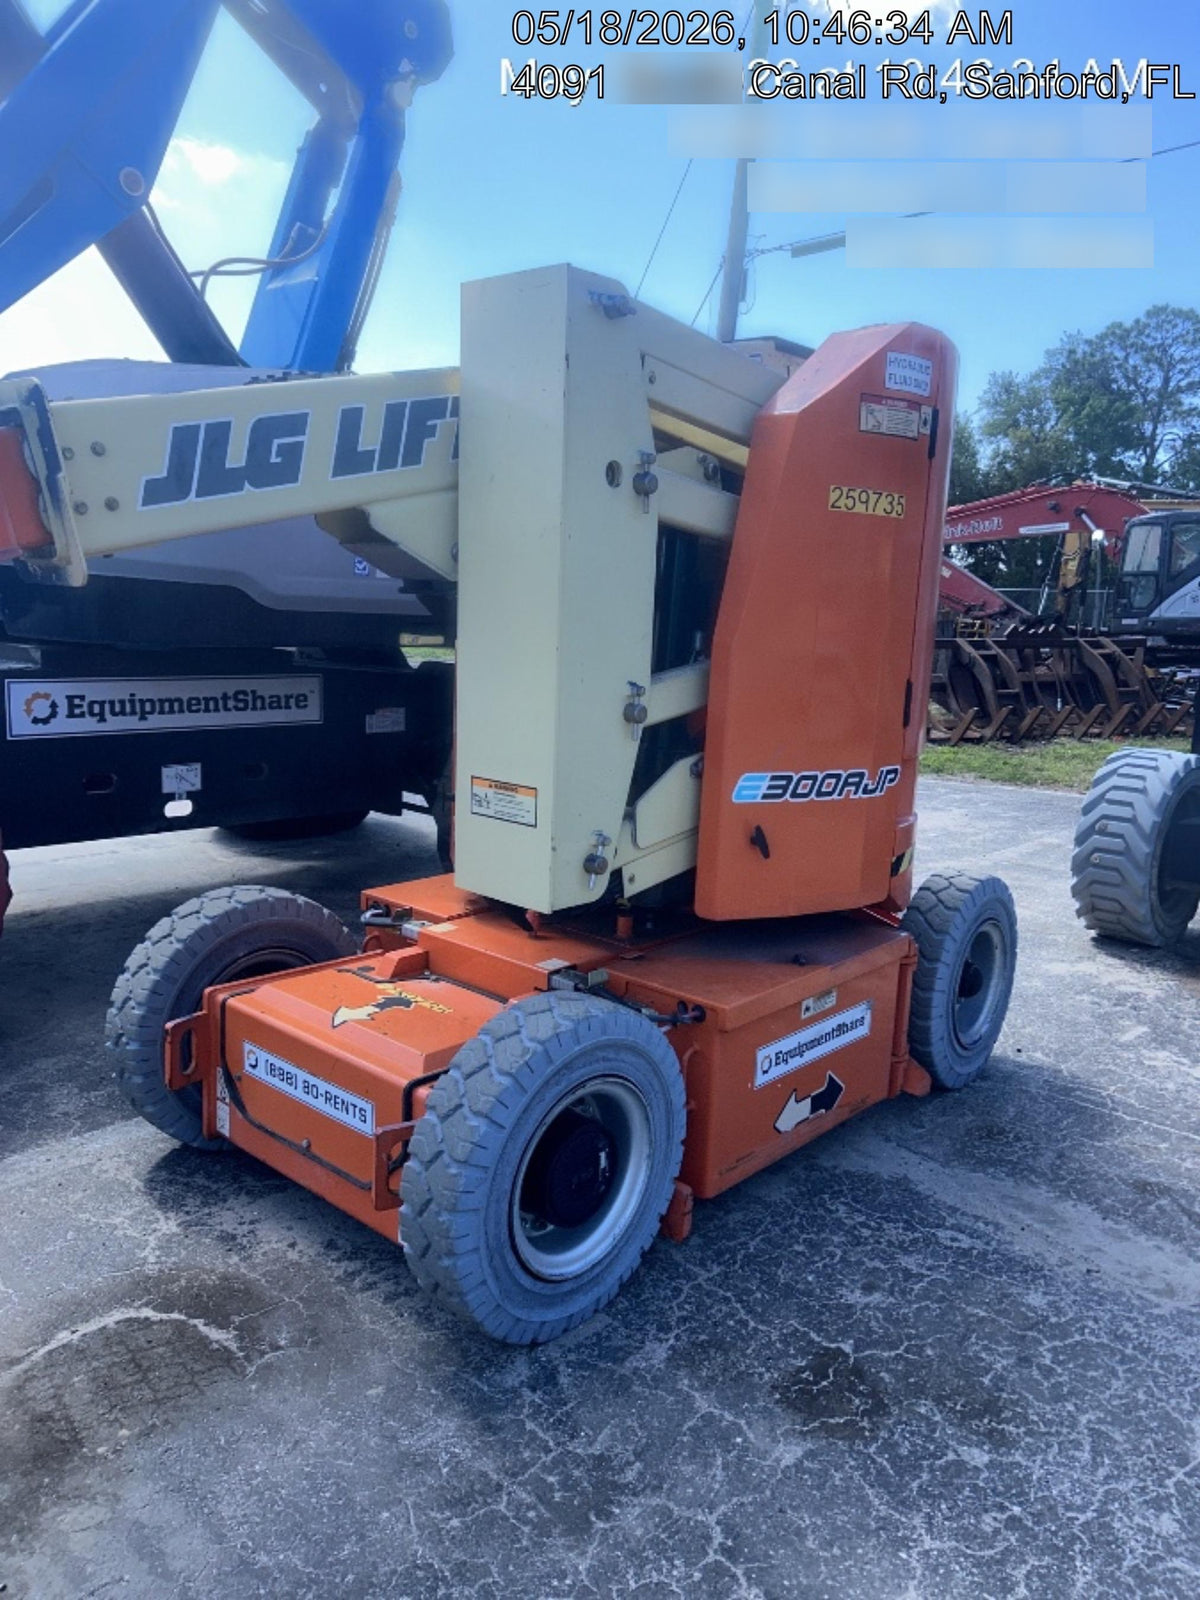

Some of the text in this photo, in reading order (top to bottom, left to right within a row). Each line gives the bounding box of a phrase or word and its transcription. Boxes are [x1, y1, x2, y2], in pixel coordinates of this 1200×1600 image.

[138, 409, 311, 511] JLG
[829, 486, 904, 517] 259735
[65, 688, 310, 724] EquipmentShare
[732, 765, 901, 803] E300AJP
[774, 1016, 866, 1067] EquipmentShare
[264, 1058, 299, 1091] (888)
[302, 1079, 368, 1125] 80-RENTS
